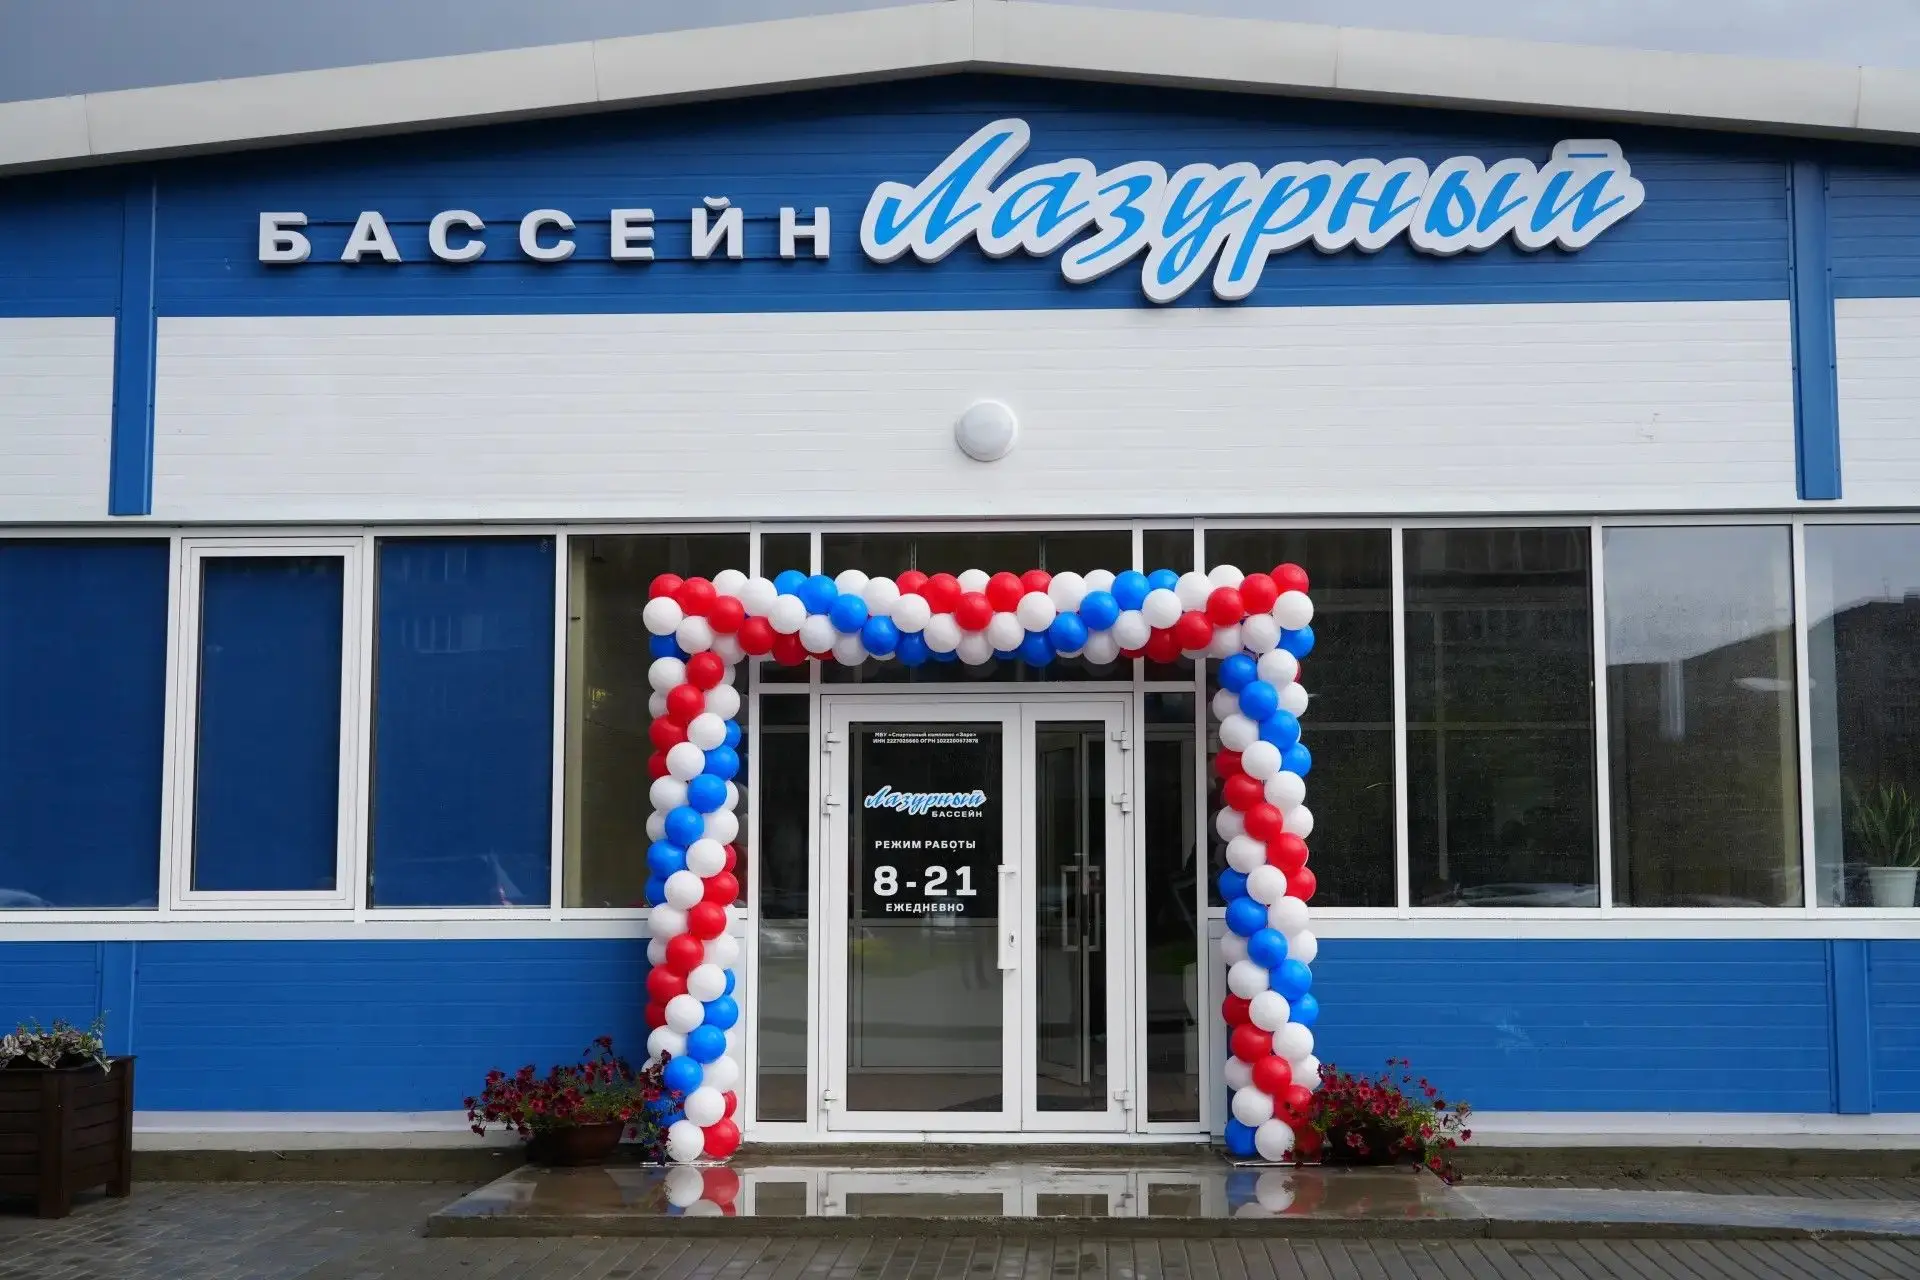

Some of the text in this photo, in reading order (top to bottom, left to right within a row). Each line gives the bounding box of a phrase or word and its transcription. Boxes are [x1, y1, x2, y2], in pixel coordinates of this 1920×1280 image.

[258, 128, 1628, 289] БАССЕЙН Лазурный
[864, 786, 986, 814] Лазурный
[931, 809, 983, 818] БАССЕЙН
[875, 840, 976, 849] РЕЖИМ РАБОТЫ
[885, 903, 965, 914] ЕЖЕДНЕВНО
